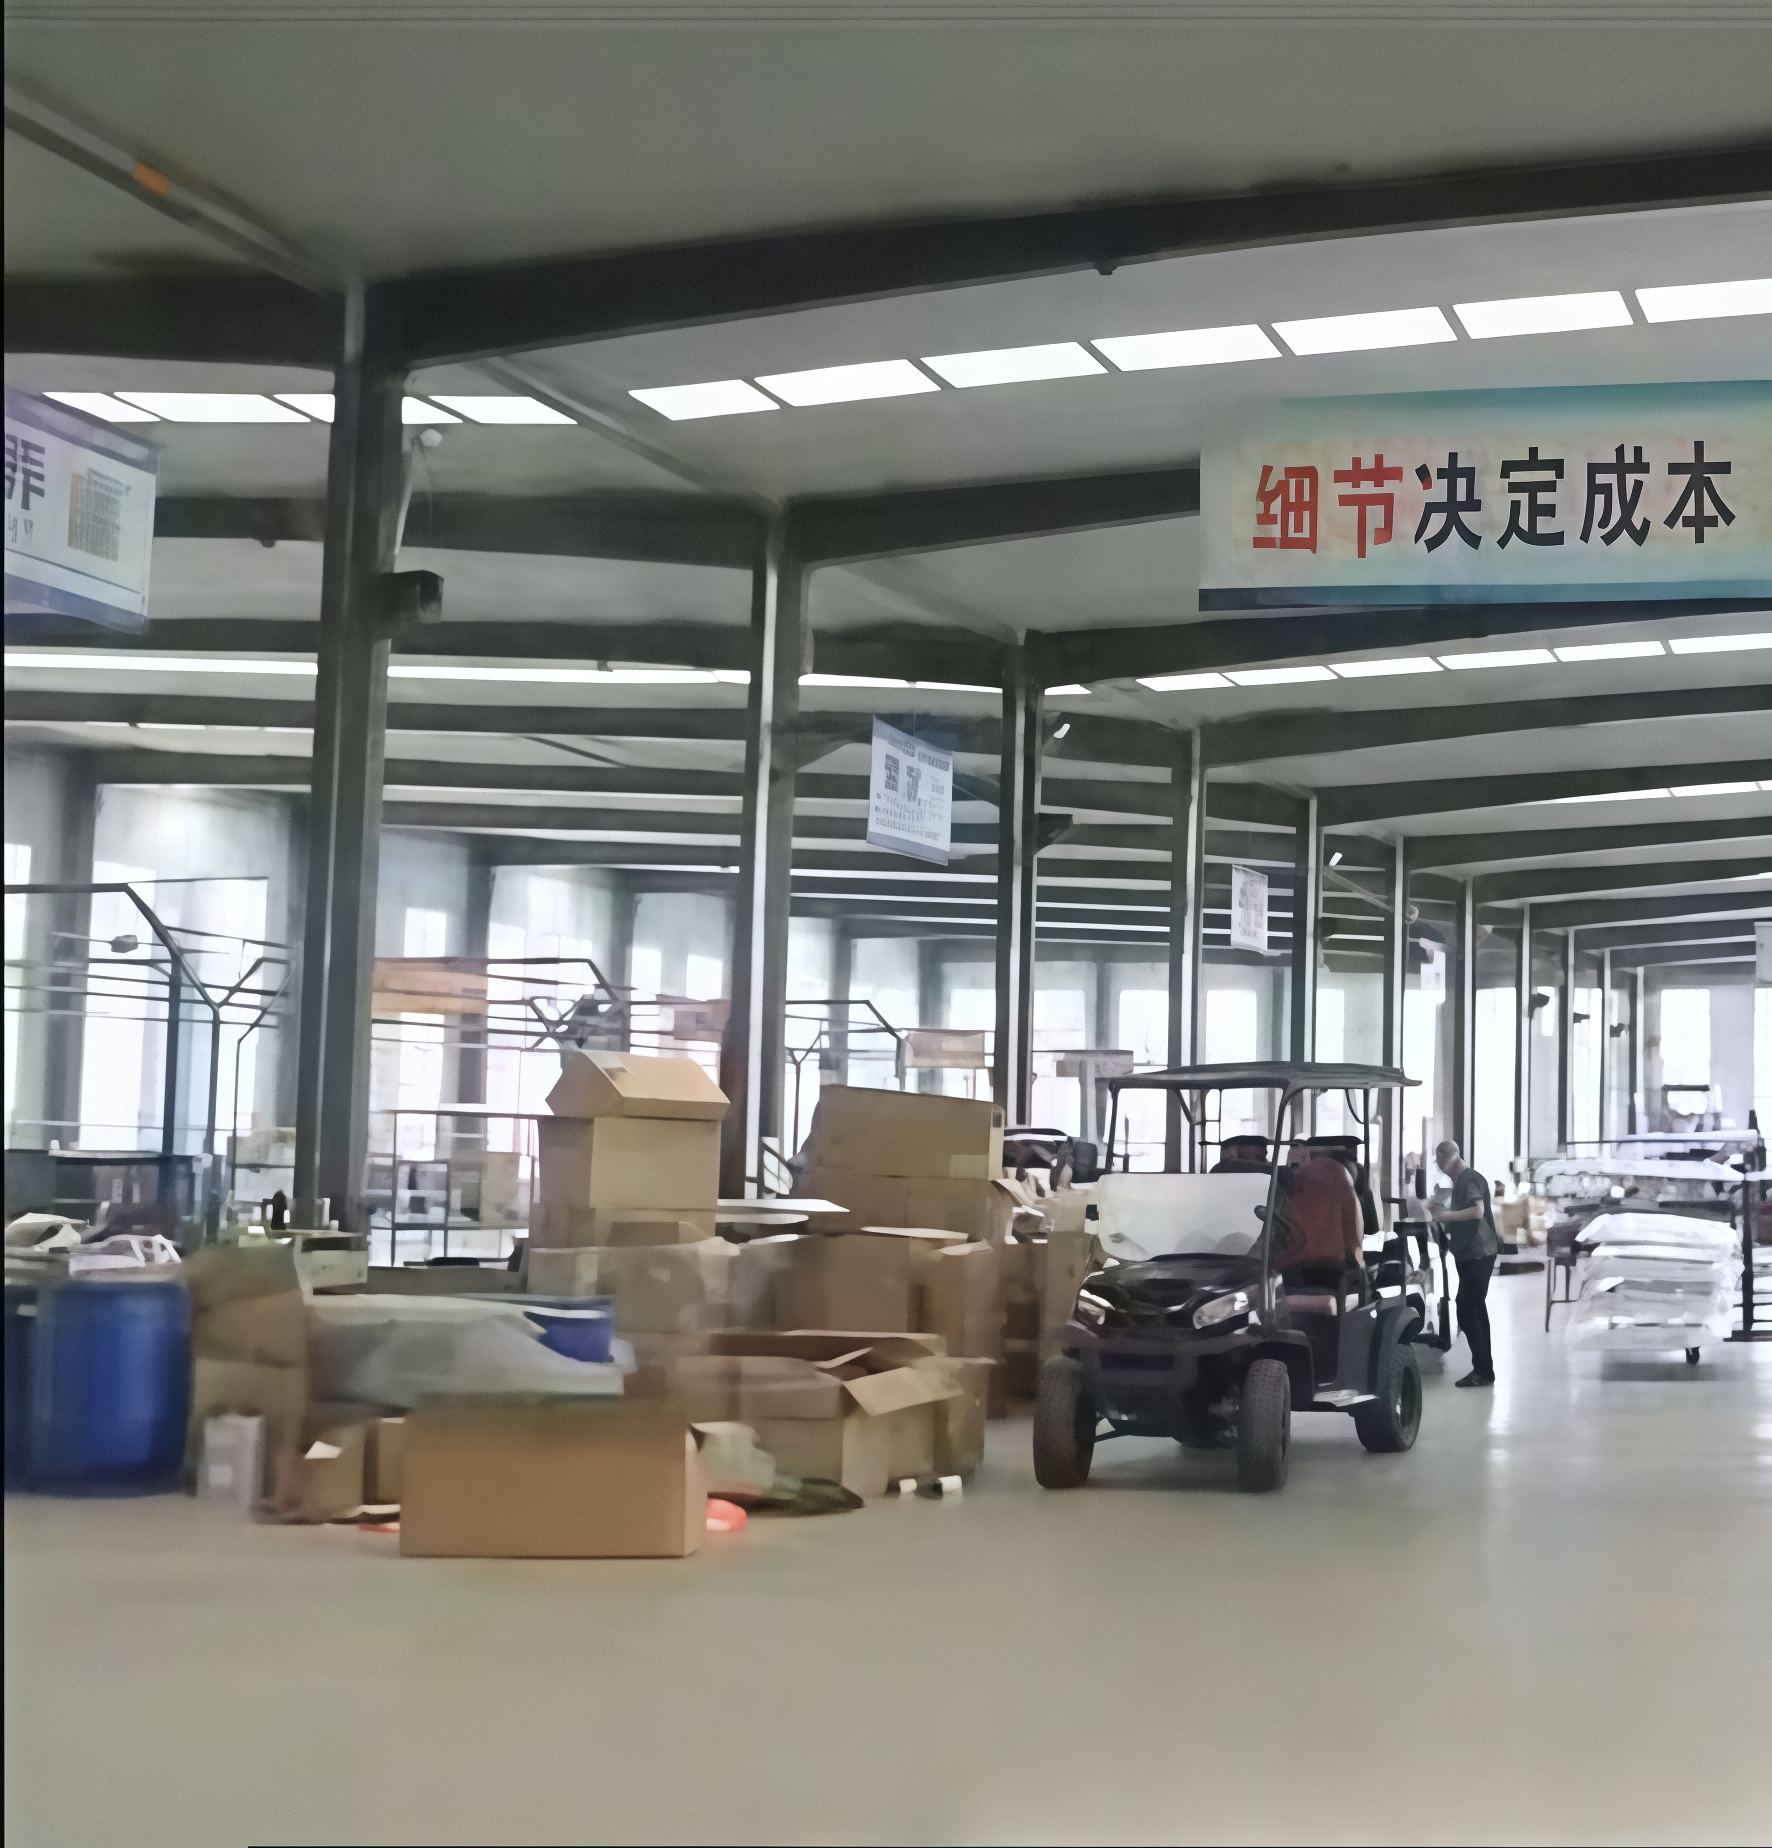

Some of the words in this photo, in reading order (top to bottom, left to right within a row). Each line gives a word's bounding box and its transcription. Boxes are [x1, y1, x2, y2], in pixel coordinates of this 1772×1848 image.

[1252, 440, 1737, 559] 细节决定成本
